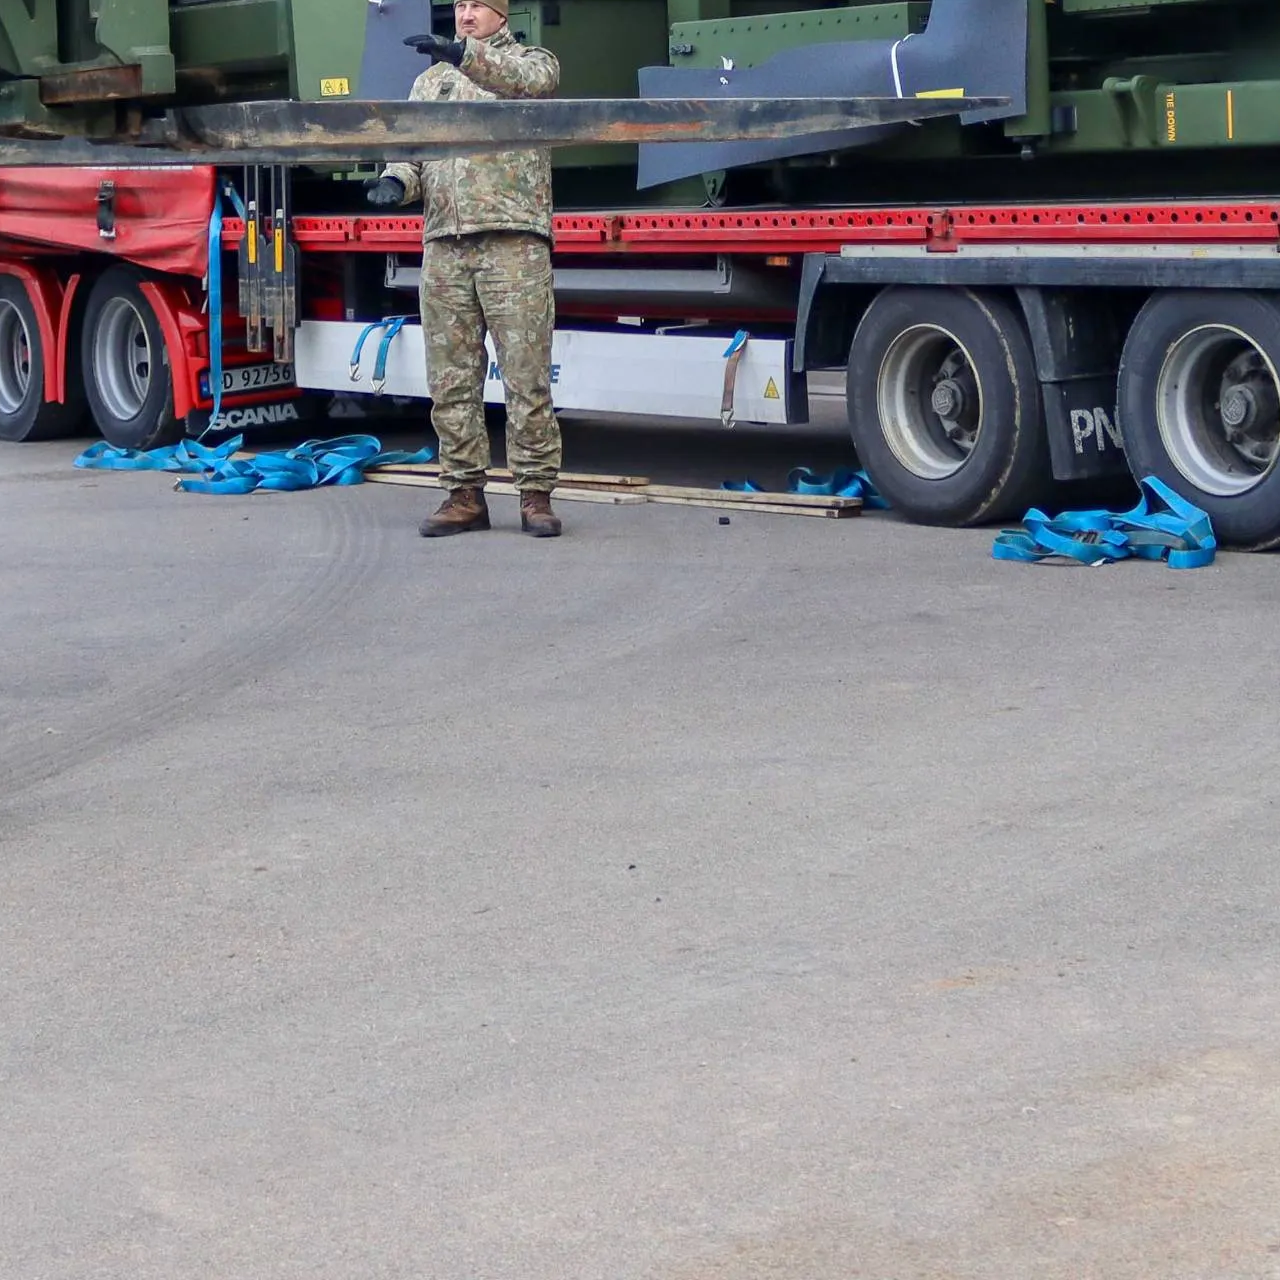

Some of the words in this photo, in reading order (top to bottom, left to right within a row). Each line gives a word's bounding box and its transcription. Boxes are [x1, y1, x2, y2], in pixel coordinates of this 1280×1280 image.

[1166, 92, 1174, 108] TIE
[1167, 110, 1176, 141] DOWN
[209, 402, 299, 431] SCANIA
[1070, 407, 1124, 454] PN
